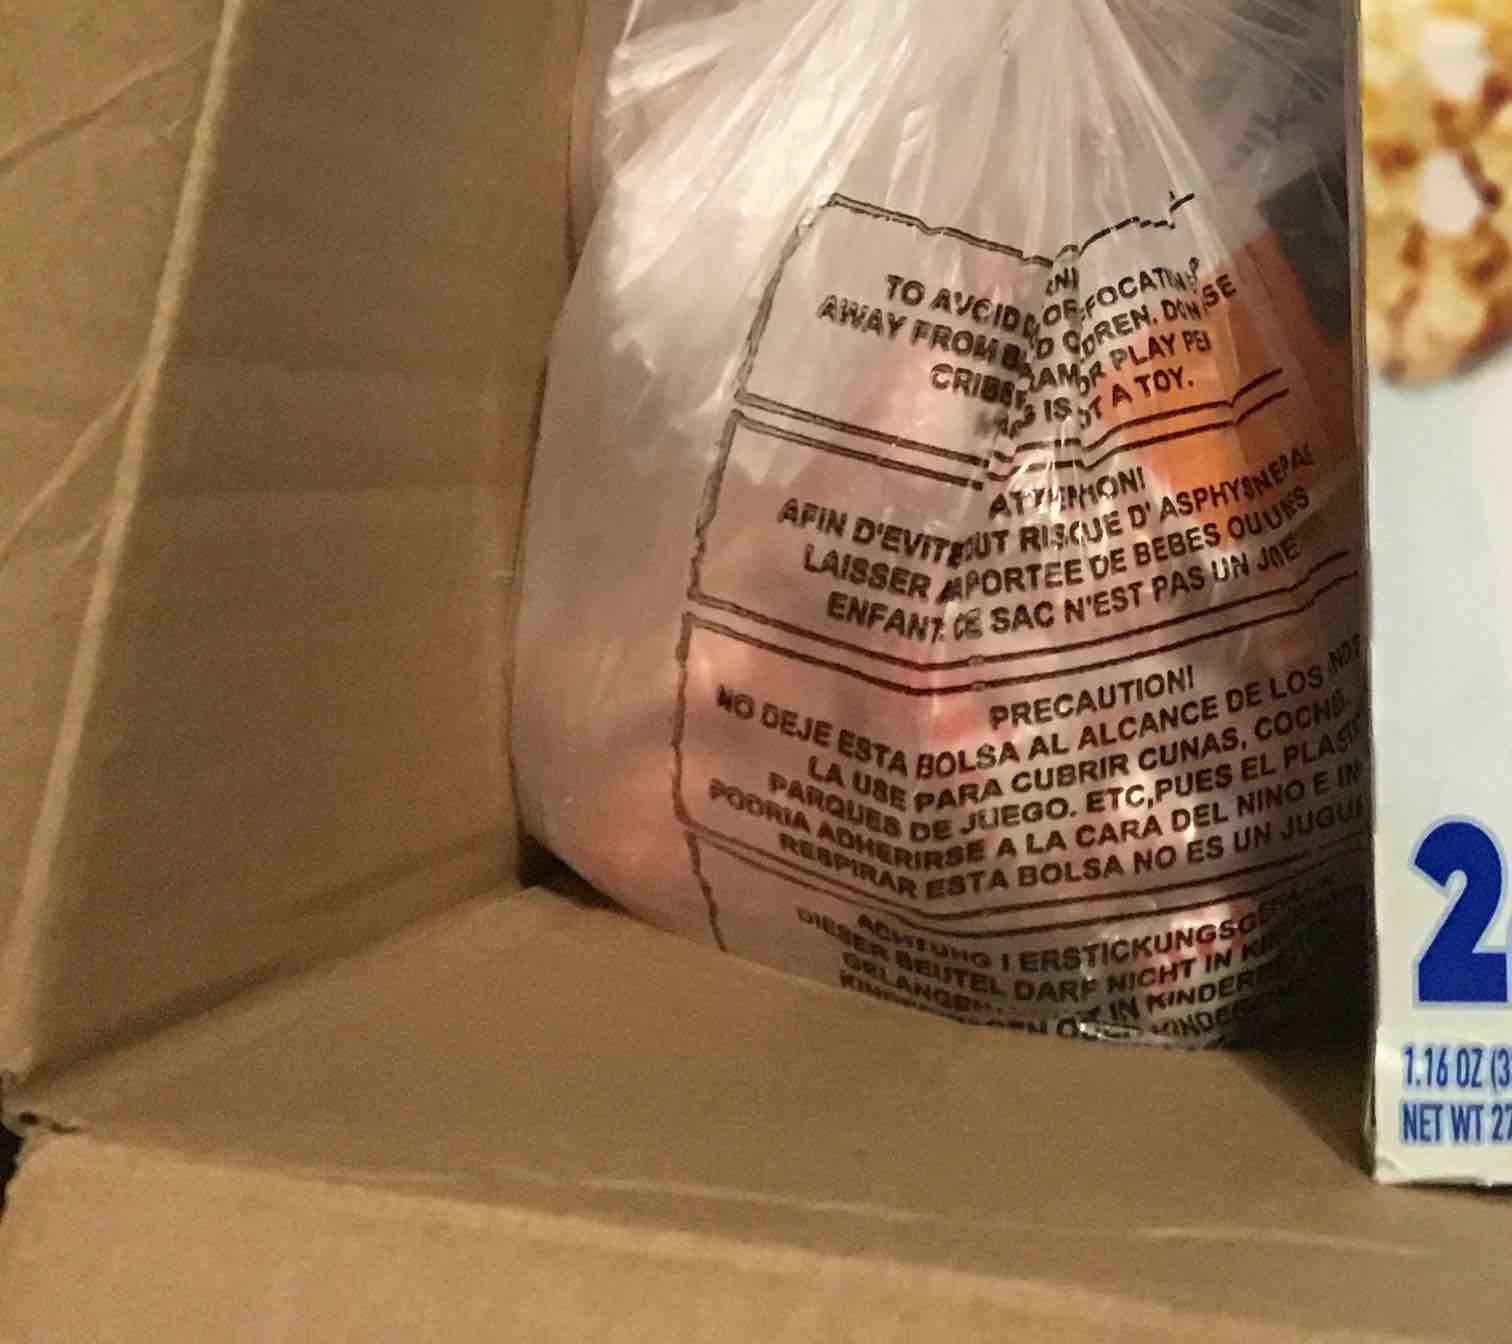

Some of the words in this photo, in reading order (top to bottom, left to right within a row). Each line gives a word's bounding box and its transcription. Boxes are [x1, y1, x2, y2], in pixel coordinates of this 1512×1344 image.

[886, 274, 926, 307] TO
[817, 294, 905, 340] AWAY
[910, 318, 998, 361] FROM
[1110, 333, 1177, 371] PLAY
[1136, 366, 1194, 395] TOY.
[778, 497, 846, 540] AFIN
[803, 543, 932, 600] LAISSER
[1135, 513, 1220, 567] BEBES
[990, 601, 1055, 634] SAC
[1063, 582, 1143, 625] N'EST
[1152, 566, 1205, 601] PAS
[717, 684, 755, 720] NO
[761, 703, 833, 748] DEJE
[838, 728, 907, 777] ESTA
[915, 740, 1020, 780] BOLSA
[1028, 733, 1069, 760] AL
[1078, 695, 1218, 751] ALCANCE
[1226, 681, 1262, 712] DE
[1269, 665, 1324, 700] LOS
[768, 771, 902, 838] PARQUES
[910, 819, 952, 843] DE
[1241, 752, 1276, 782] EL
[808, 755, 844, 788] LA
[852, 771, 907, 812] USE
[914, 777, 1003, 813] PARA
[1012, 753, 1129, 794] CUBRIR
[818, 821, 987, 872] ADHERIRSE
[1026, 828, 1066, 854] LA
[1075, 814, 1163, 849] CARA
[1171, 803, 1228, 833] DEL
[1238, 779, 1305, 819] NINO
[778, 832, 918, 899] RESPIRAR
[926, 869, 1010, 901] ESTA
[1018, 854, 1126, 888] BOLSA
[1134, 844, 1177, 875] NO
[1186, 836, 1224, 863] ES
[1234, 822, 1272, 853] UN
[1014, 975, 1099, 1005] DARF
[1105, 959, 1194, 994] NICHT
[1403, 1046, 1448, 1088] 1.16
[1457, 1047, 1482, 1088] OZ
[1401, 1103, 1442, 1144] NET
[1451, 1102, 1484, 1143] WT
